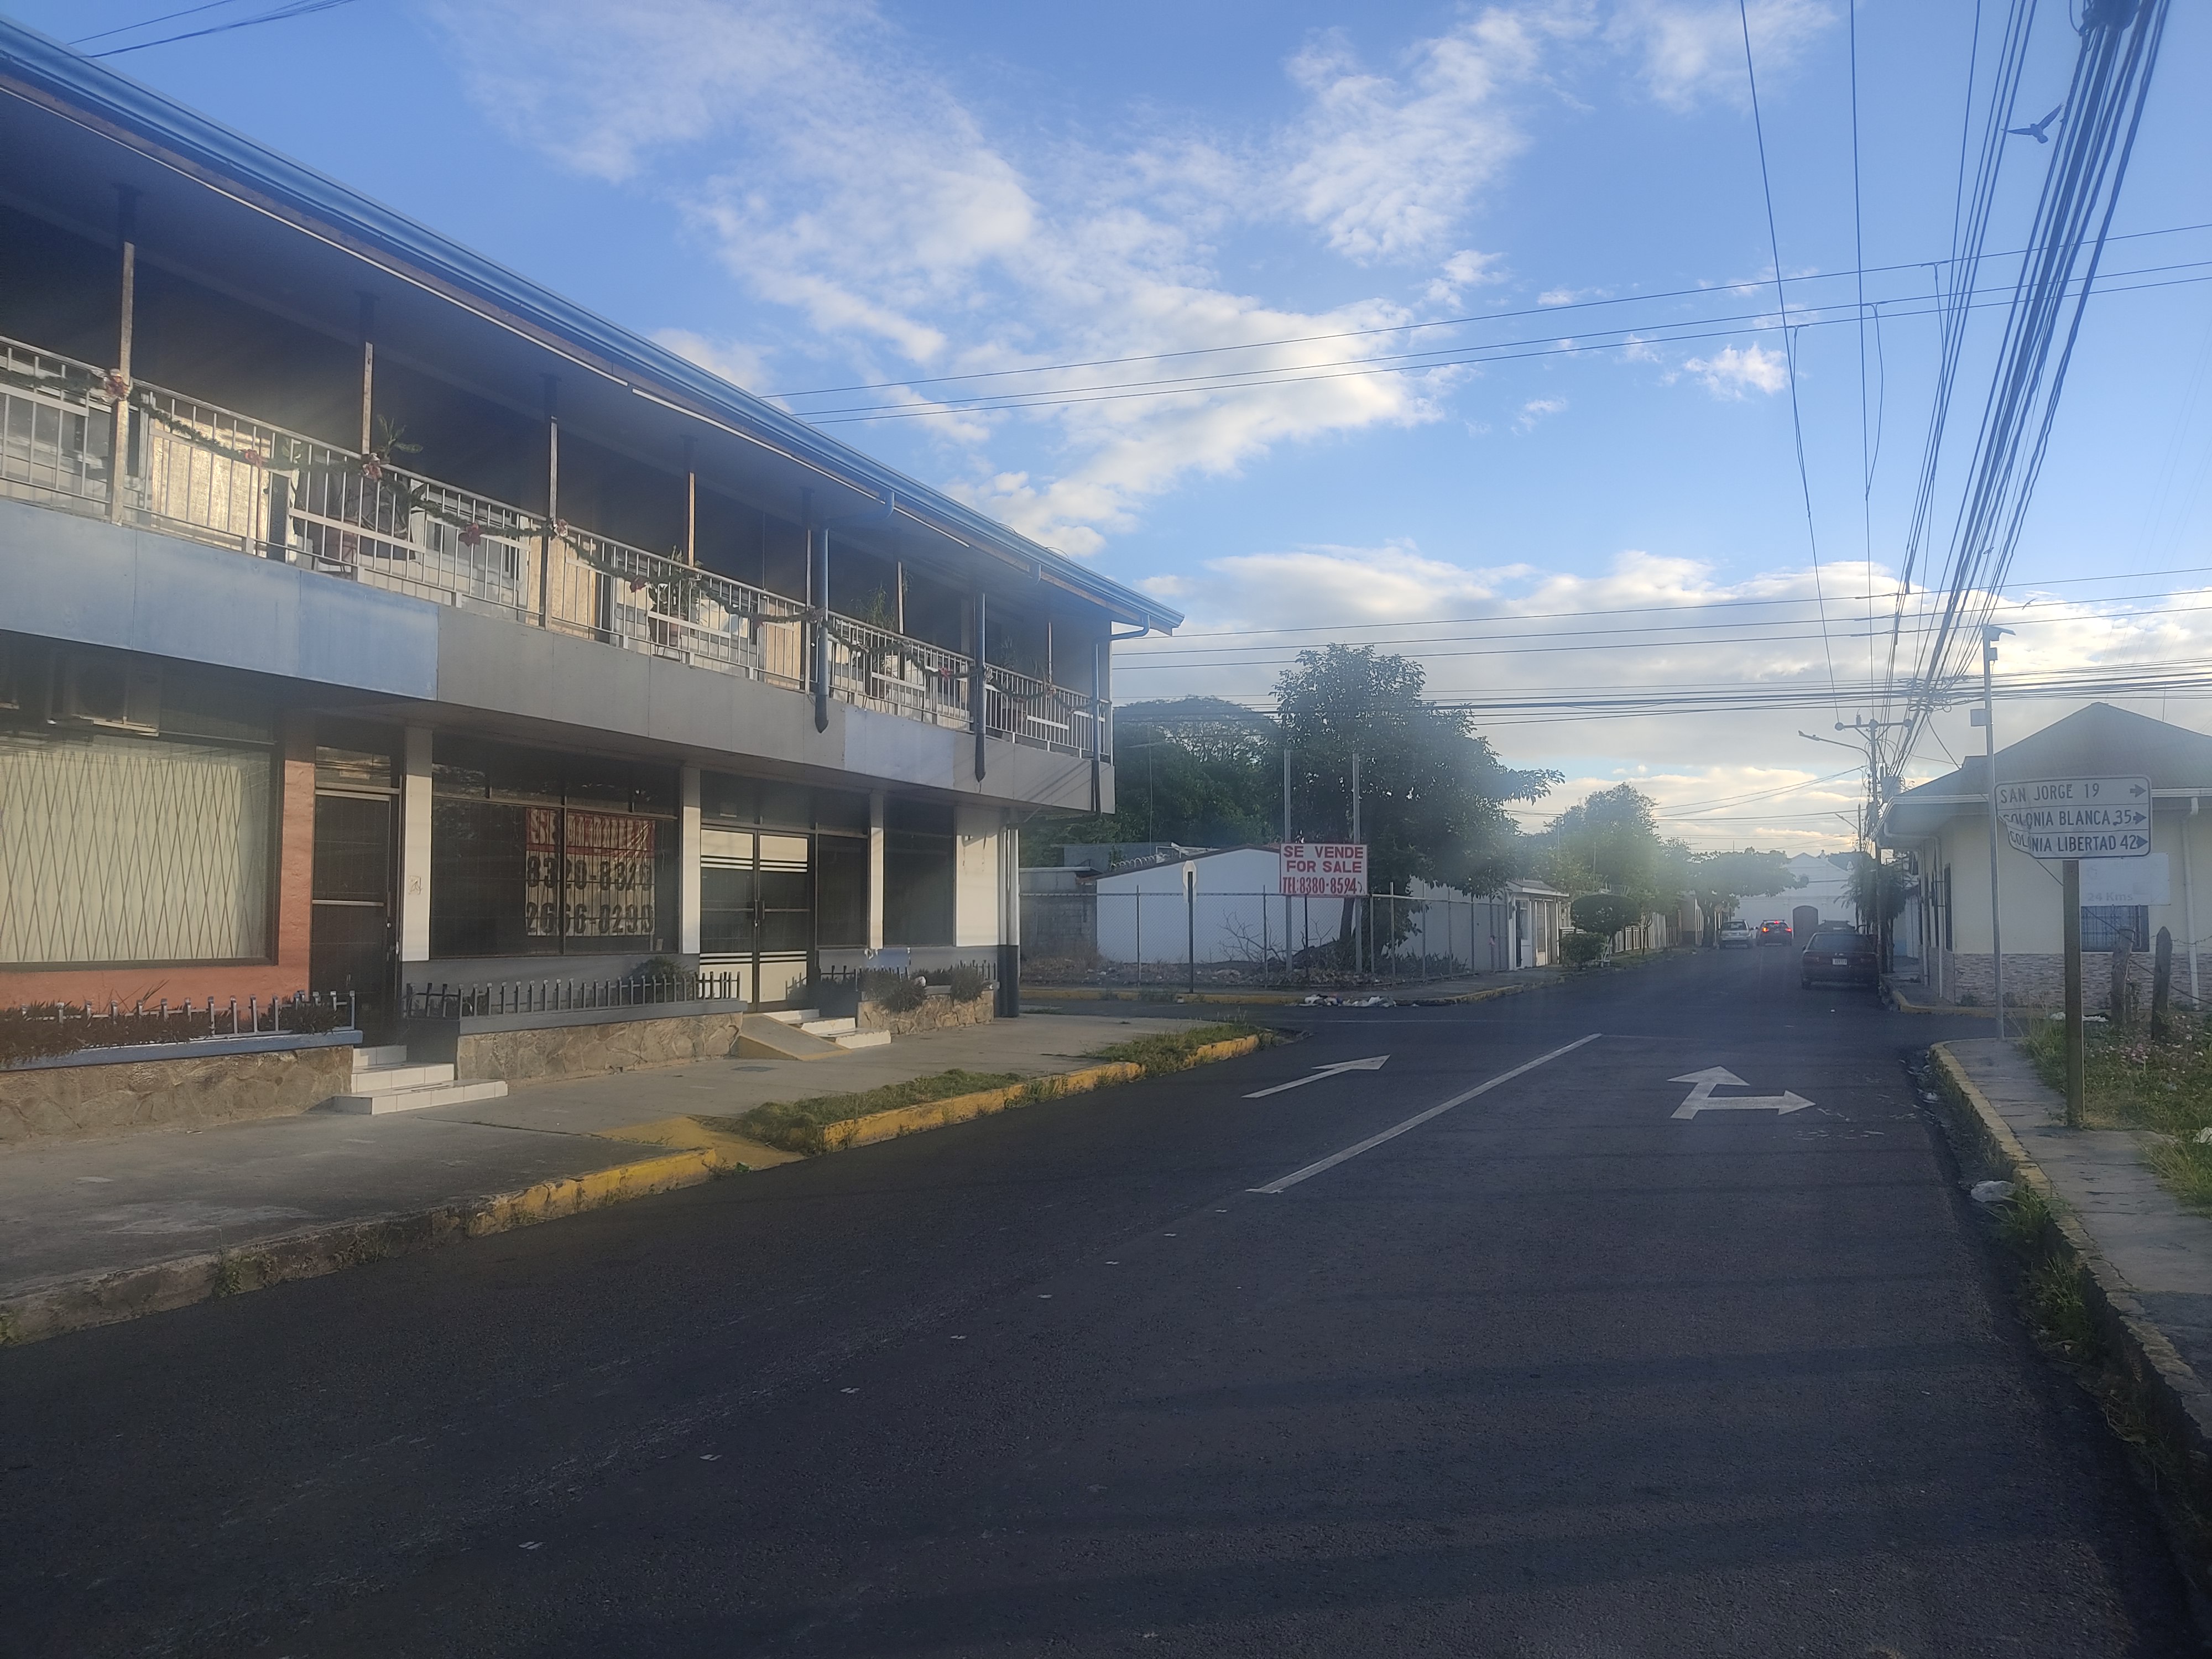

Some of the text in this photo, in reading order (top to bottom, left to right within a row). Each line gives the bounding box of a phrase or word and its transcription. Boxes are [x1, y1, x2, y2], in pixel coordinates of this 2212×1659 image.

[2000, 783, 2099, 804] SAN JORGE 19
[2059, 810, 2110, 826] BLANCA
[2114, 810, 2132, 826] 35
[2009, 831, 2137, 852] COLONIA LIBERTAD 42
[1283, 846, 1363, 858] SE VENDE
[1286, 860, 1361, 873] FOR SALE
[2106, 892, 2133, 901] Kms
